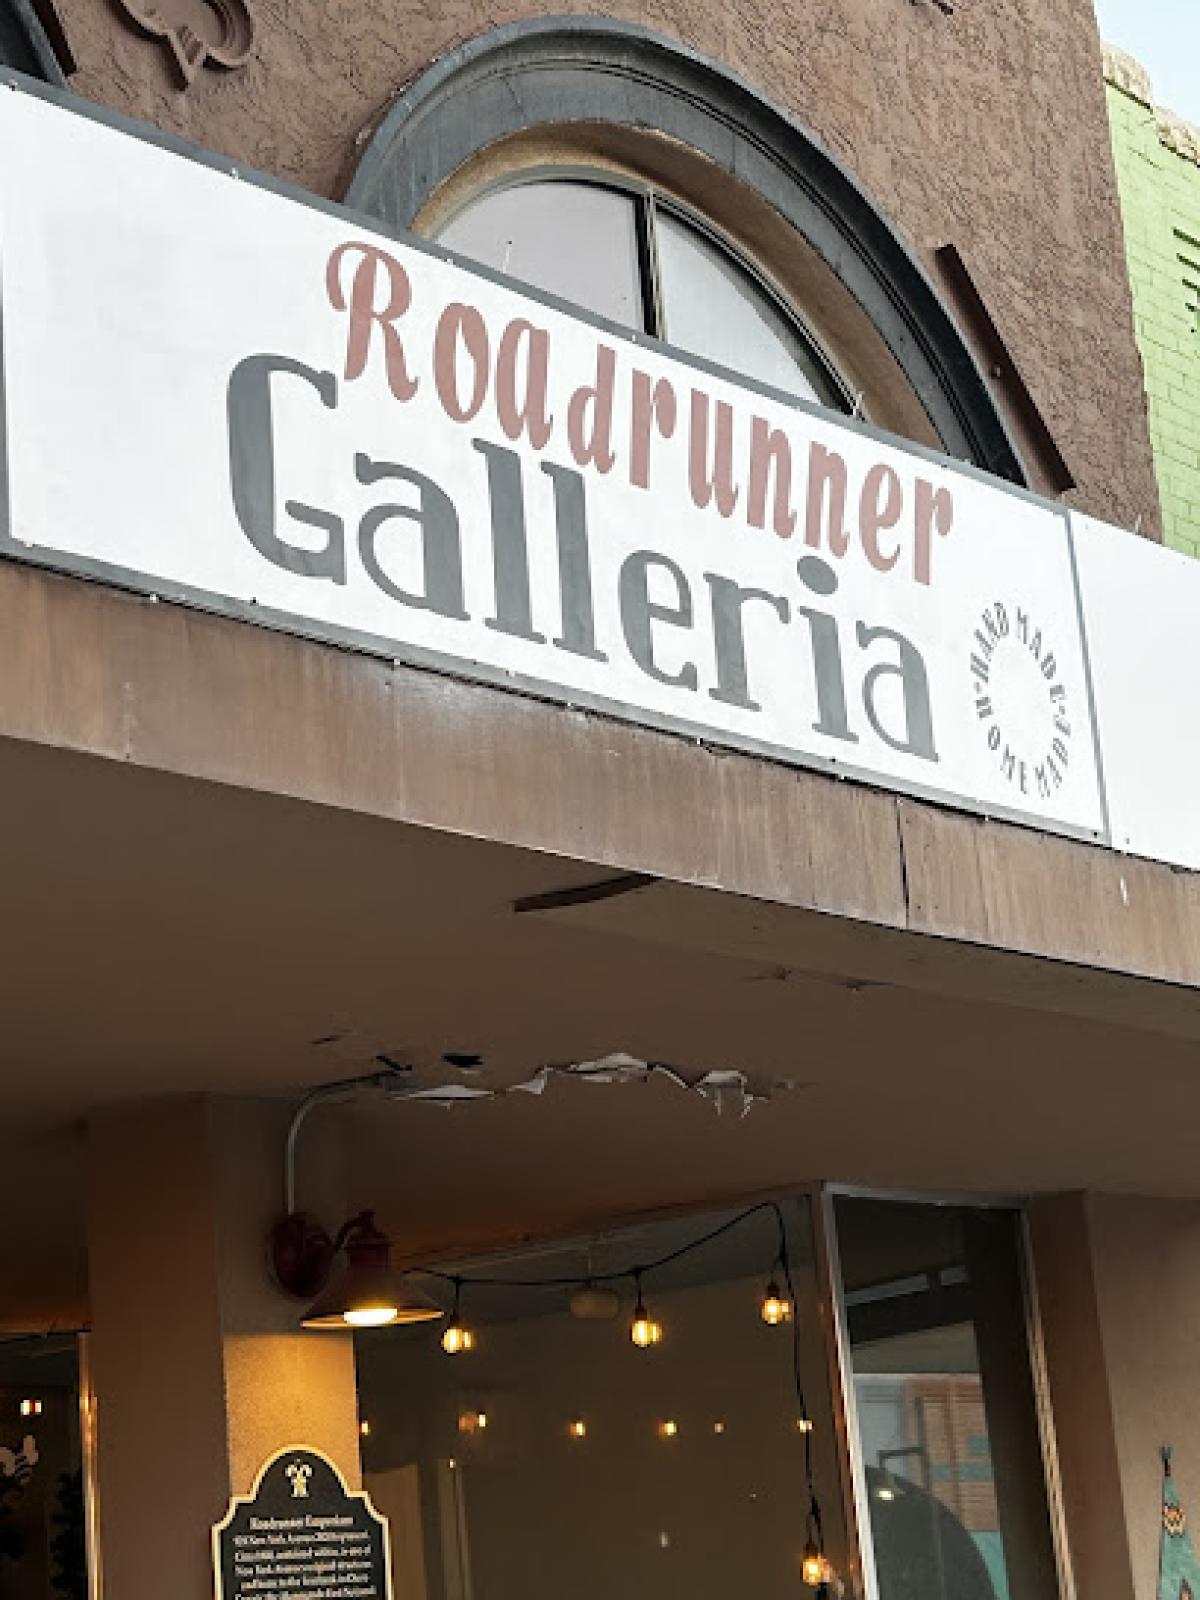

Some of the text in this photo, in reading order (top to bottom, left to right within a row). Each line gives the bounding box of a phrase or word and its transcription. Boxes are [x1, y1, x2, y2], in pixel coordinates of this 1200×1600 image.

[226, 353, 939, 762] Galleria
[326, 241, 953, 586] Roadrunner
[970, 602, 1066, 704] HAND MADE
